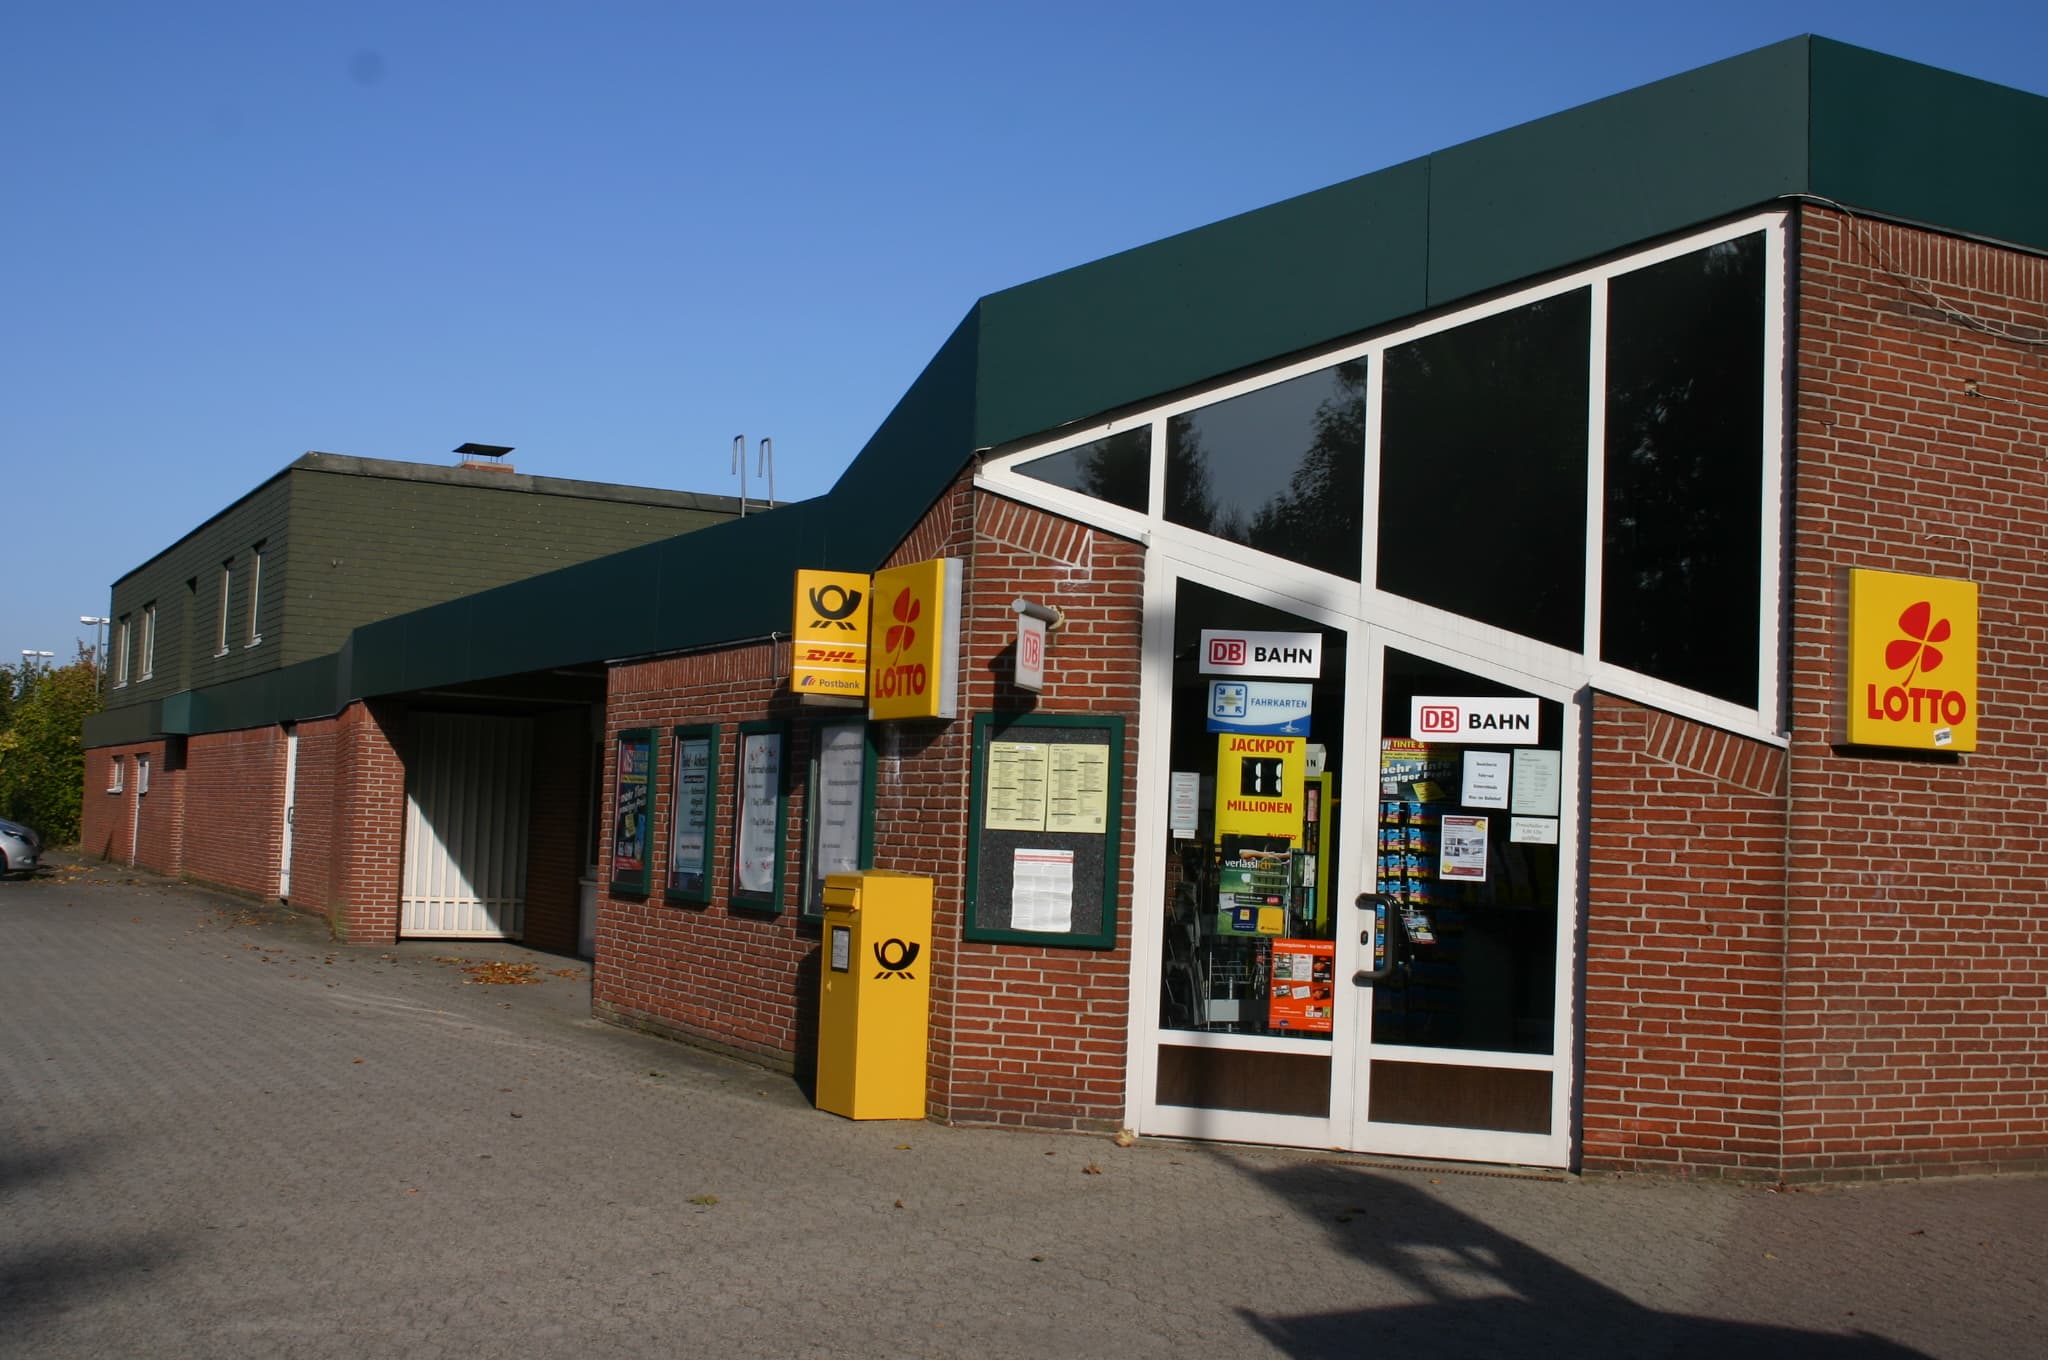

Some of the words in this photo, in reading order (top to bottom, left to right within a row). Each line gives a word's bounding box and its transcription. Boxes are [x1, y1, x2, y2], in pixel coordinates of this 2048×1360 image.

[806, 649, 857, 663] DHL
[1024, 637, 1039, 664] DB
[1213, 643, 1242, 661] DB
[1254, 647, 1313, 664] BAHN
[819, 678, 860, 689] Postbank
[874, 663, 926, 698] LOTTO
[1250, 698, 1307, 709] FAHRKARTEN
[1867, 683, 1966, 726] LOTTO
[1425, 710, 1455, 729] DB
[1468, 713, 1530, 730] BAHN
[1229, 738, 1295, 754] JACKPOT
[1393, 740, 1416, 748] TINTE
[1255, 762, 1282, 793] 11
[1227, 800, 1293, 814] MILLIONEN
